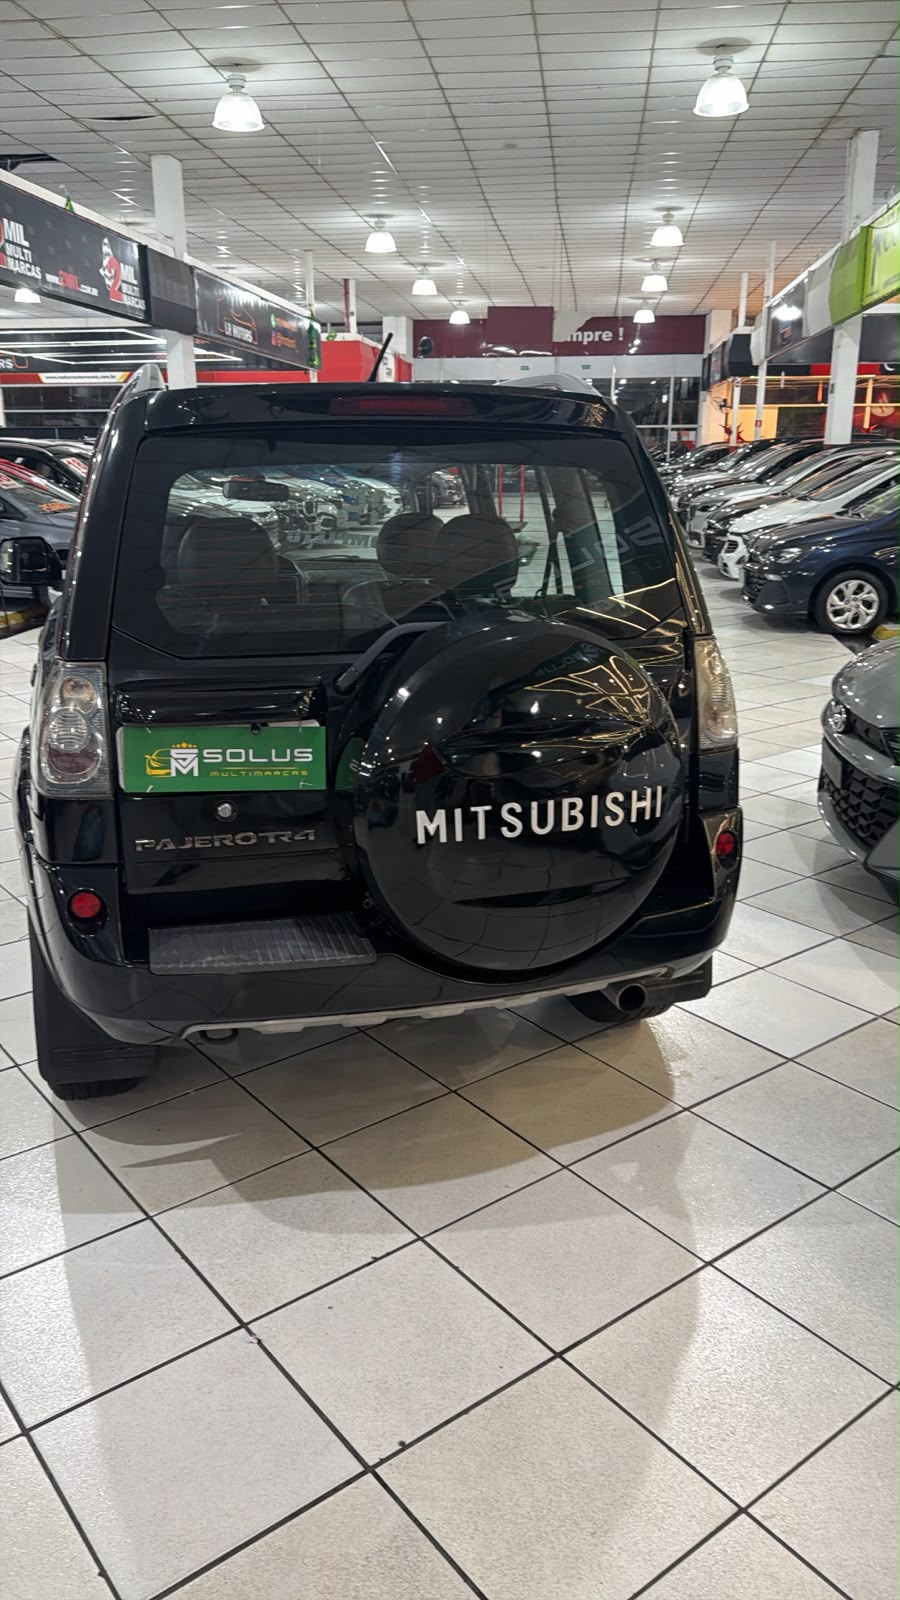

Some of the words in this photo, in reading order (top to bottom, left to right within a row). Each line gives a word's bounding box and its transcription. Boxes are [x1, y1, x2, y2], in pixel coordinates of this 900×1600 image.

[3, 217, 30, 248] MIL
[5, 242, 33, 263] MULTI
[7, 256, 42, 280] MARCAS
[202, 748, 314, 763] SOLUS
[415, 785, 663, 845] MITSUBISHI
[135, 832, 258, 852] PAJERO
[258, 829, 316, 843] TR4
